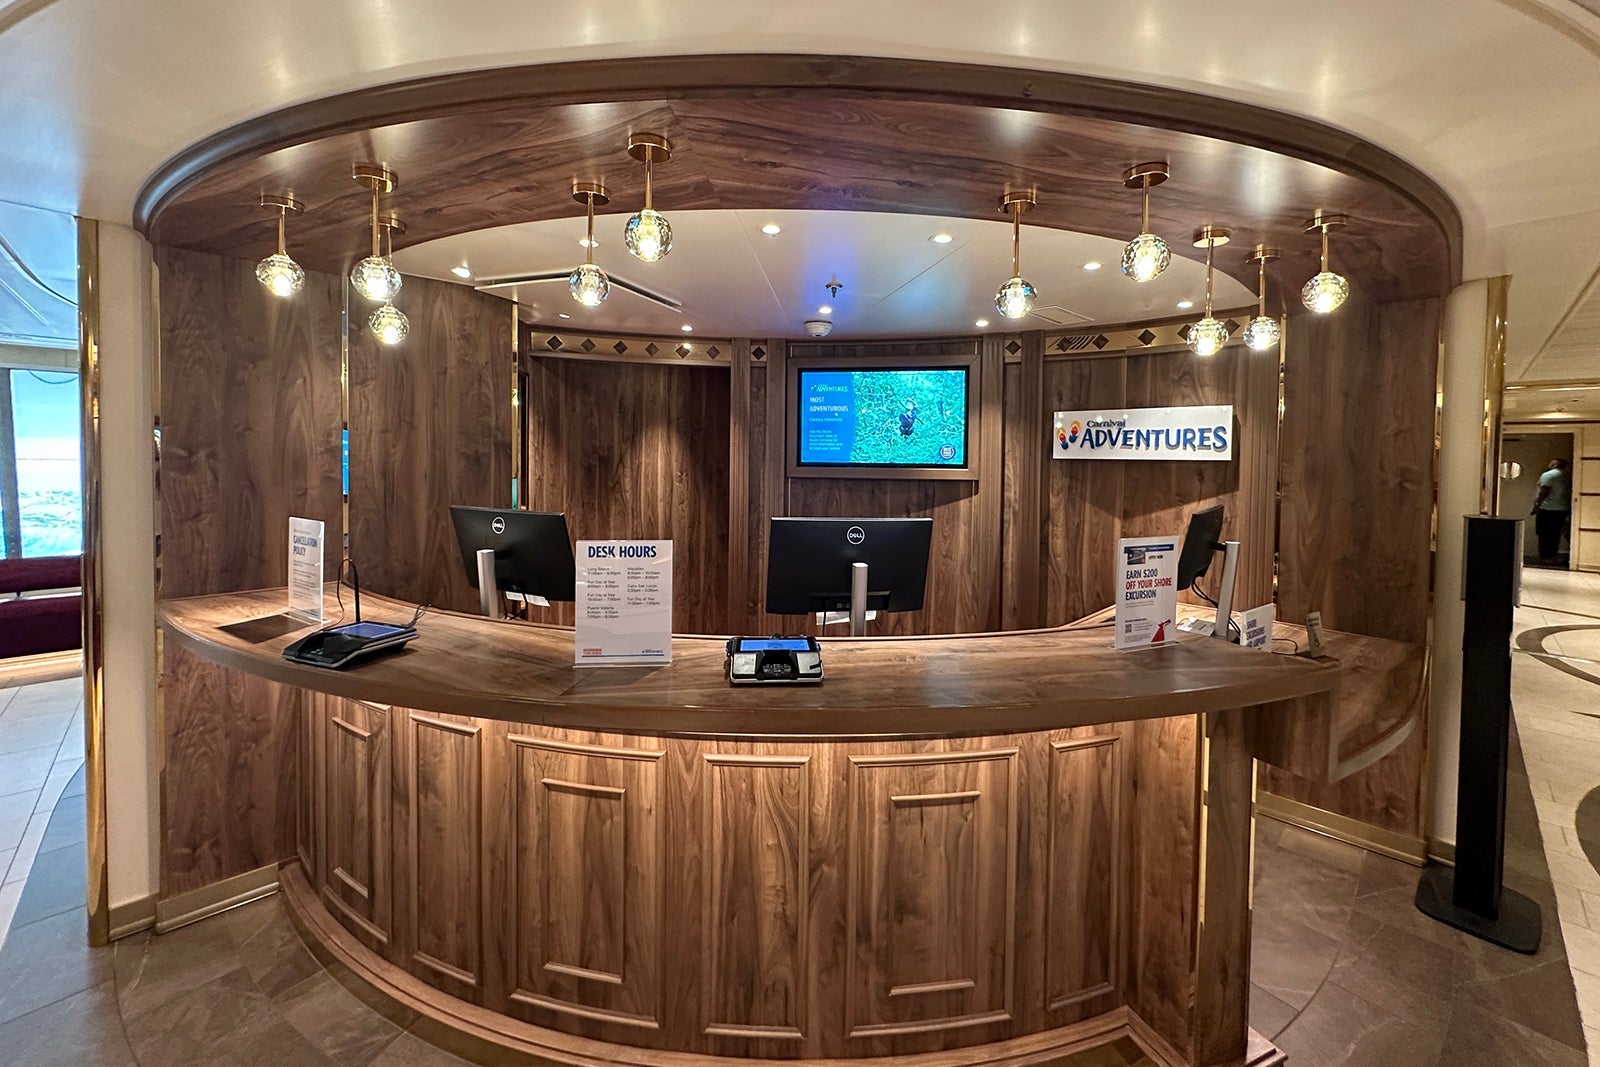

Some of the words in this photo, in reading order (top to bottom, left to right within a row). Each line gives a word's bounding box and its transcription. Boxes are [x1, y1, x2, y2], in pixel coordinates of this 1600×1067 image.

[1086, 419, 1126, 428] Carnival
[1080, 426, 1228, 452] ADVENTURES
[293, 545, 306, 556] POLICY
[588, 546, 615, 558] DESK
[619, 545, 657, 558] HOURS
[1126, 570, 1141, 579] EARN
[1143, 569, 1158, 578] $200
[1126, 581, 1136, 590] OFF
[1138, 579, 1153, 589] YOUR
[1154, 578, 1172, 587] SHORE
[1125, 589, 1156, 600] EXCURSION
